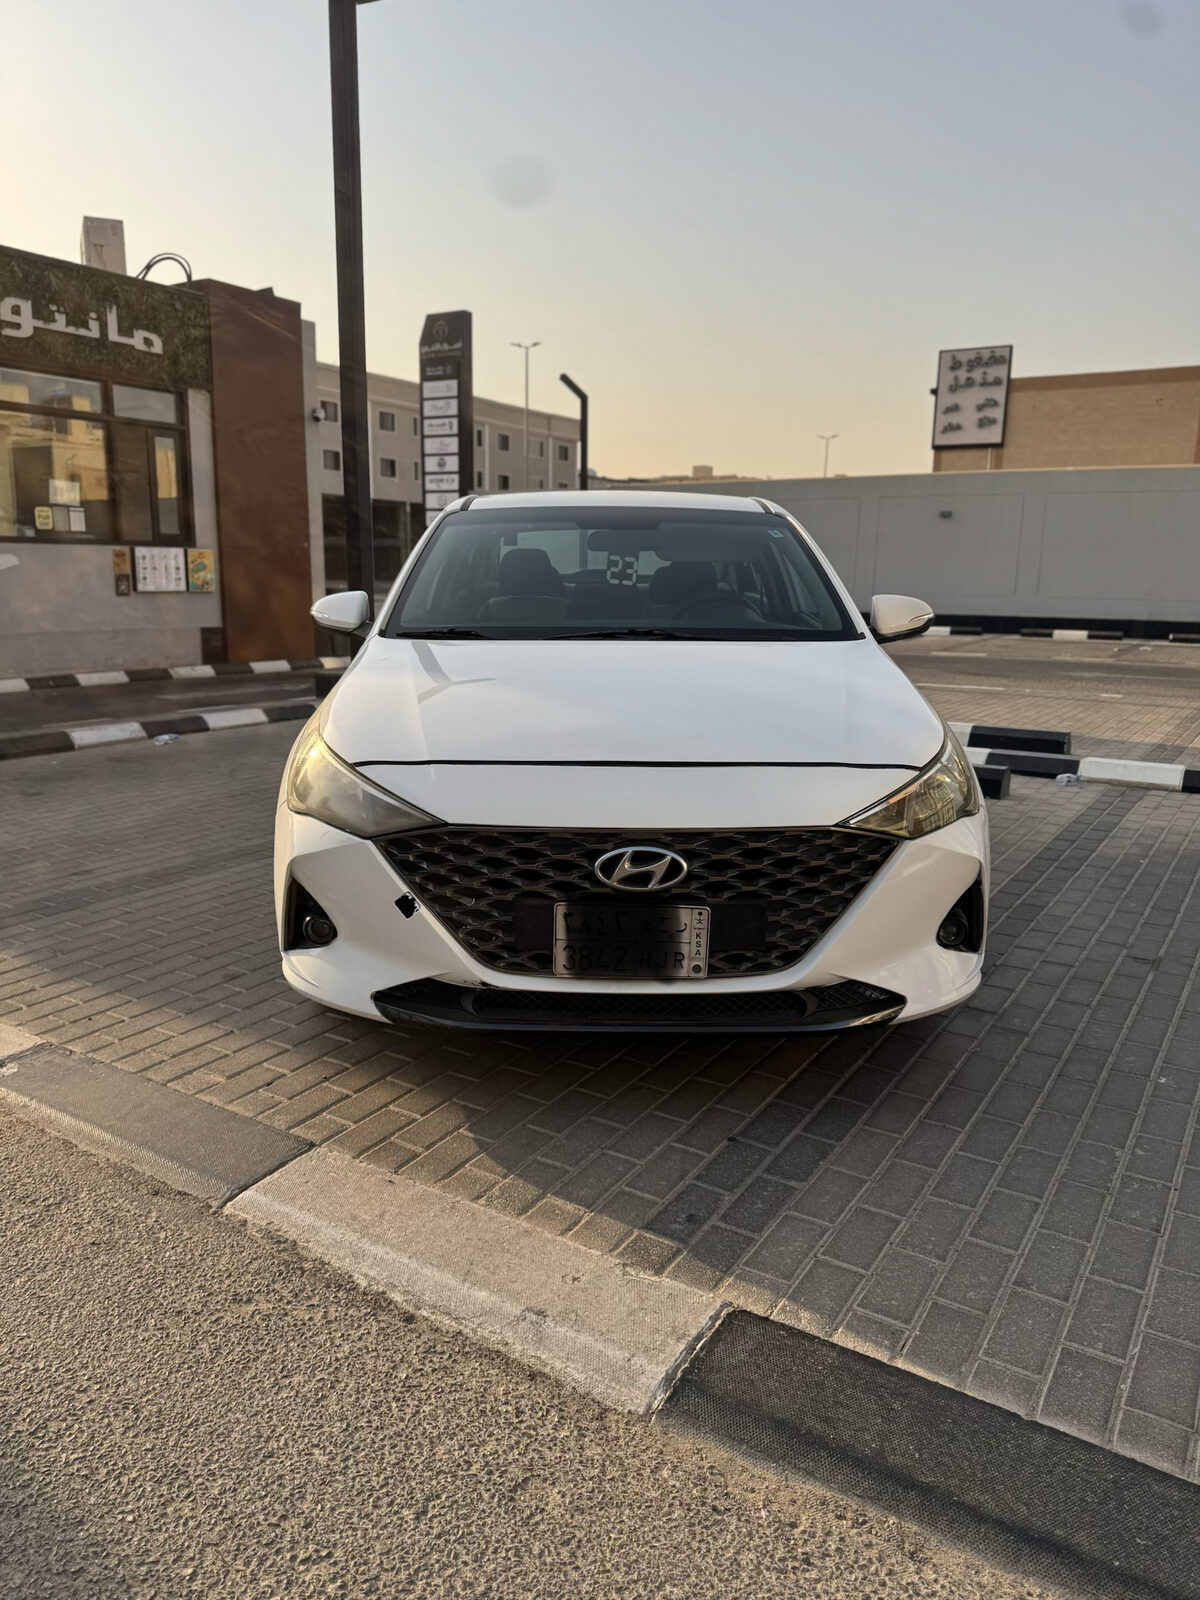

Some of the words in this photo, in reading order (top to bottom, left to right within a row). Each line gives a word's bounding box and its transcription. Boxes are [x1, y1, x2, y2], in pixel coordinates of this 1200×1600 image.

[606, 555, 638, 586] 23
[562, 945, 627, 971] 3842
[639, 951, 685, 969] HJR
